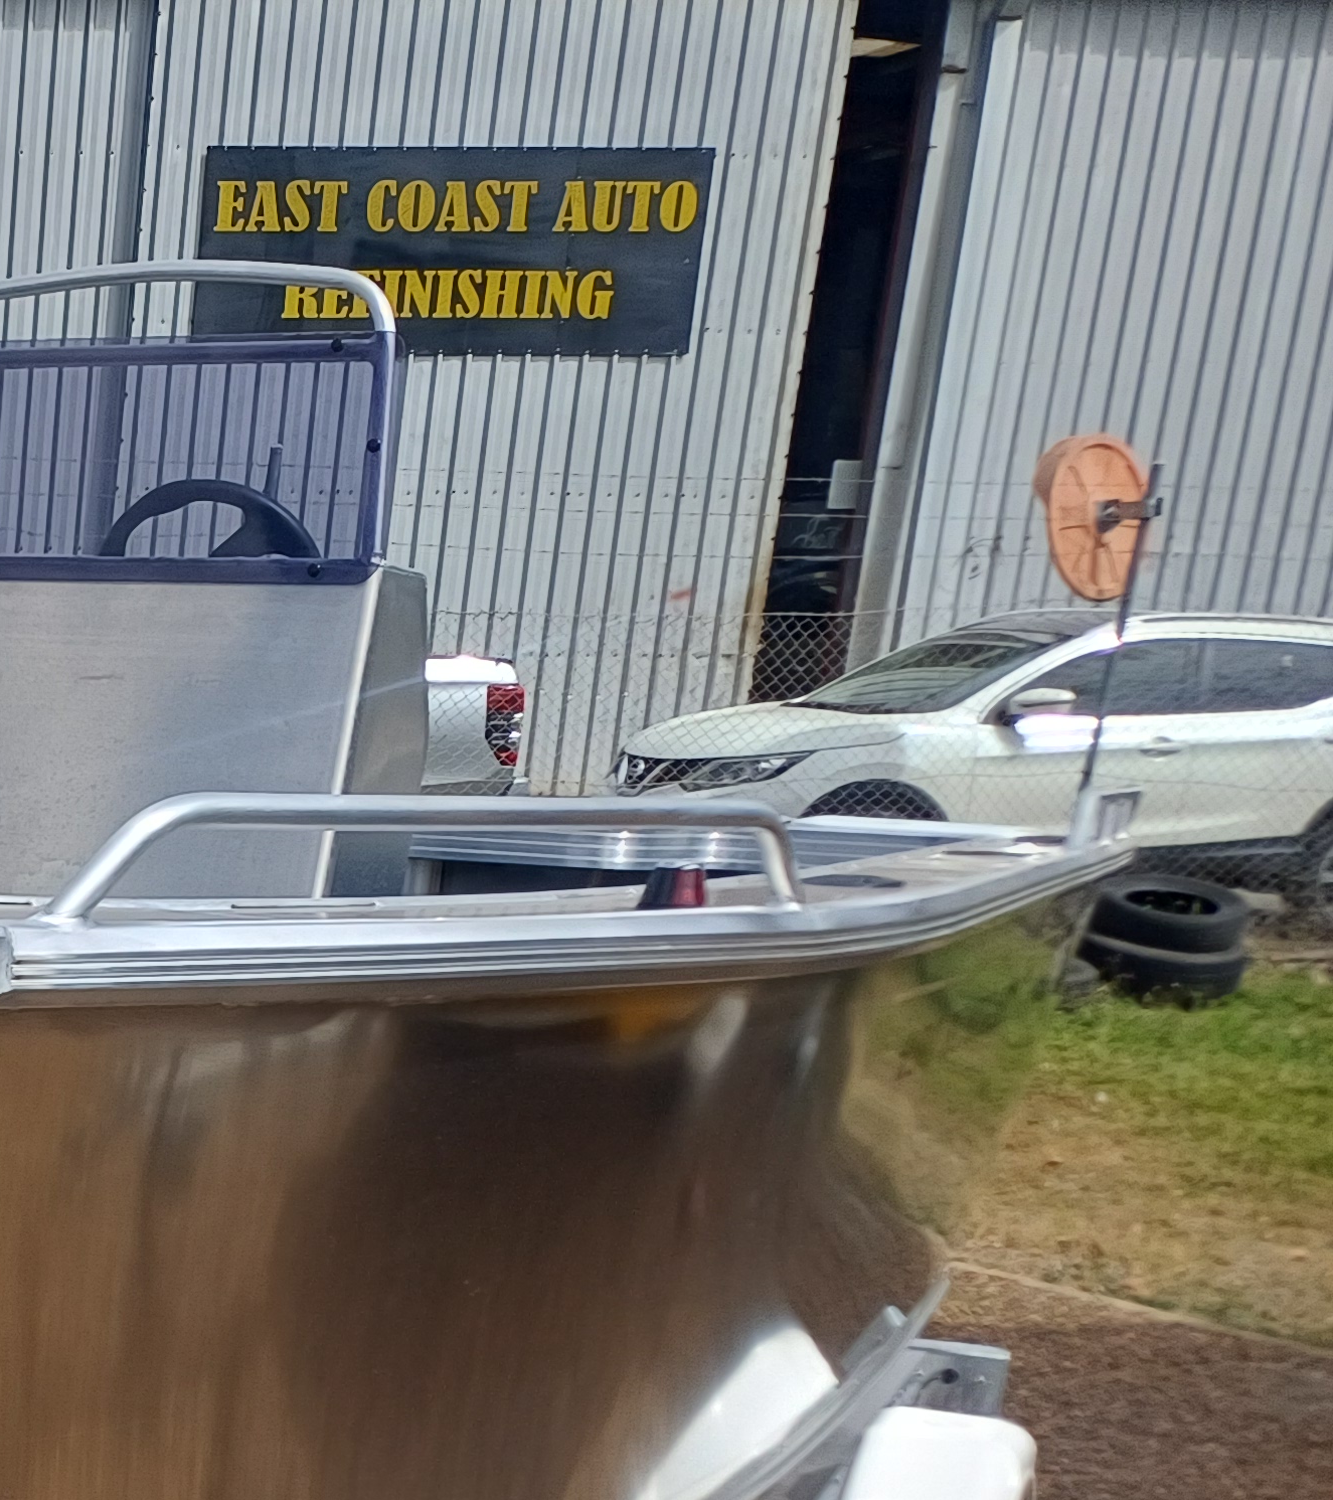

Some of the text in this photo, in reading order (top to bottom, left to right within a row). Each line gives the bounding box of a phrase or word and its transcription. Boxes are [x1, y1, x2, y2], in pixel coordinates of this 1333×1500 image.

[213, 178, 700, 234] EAST COAST AUTO
